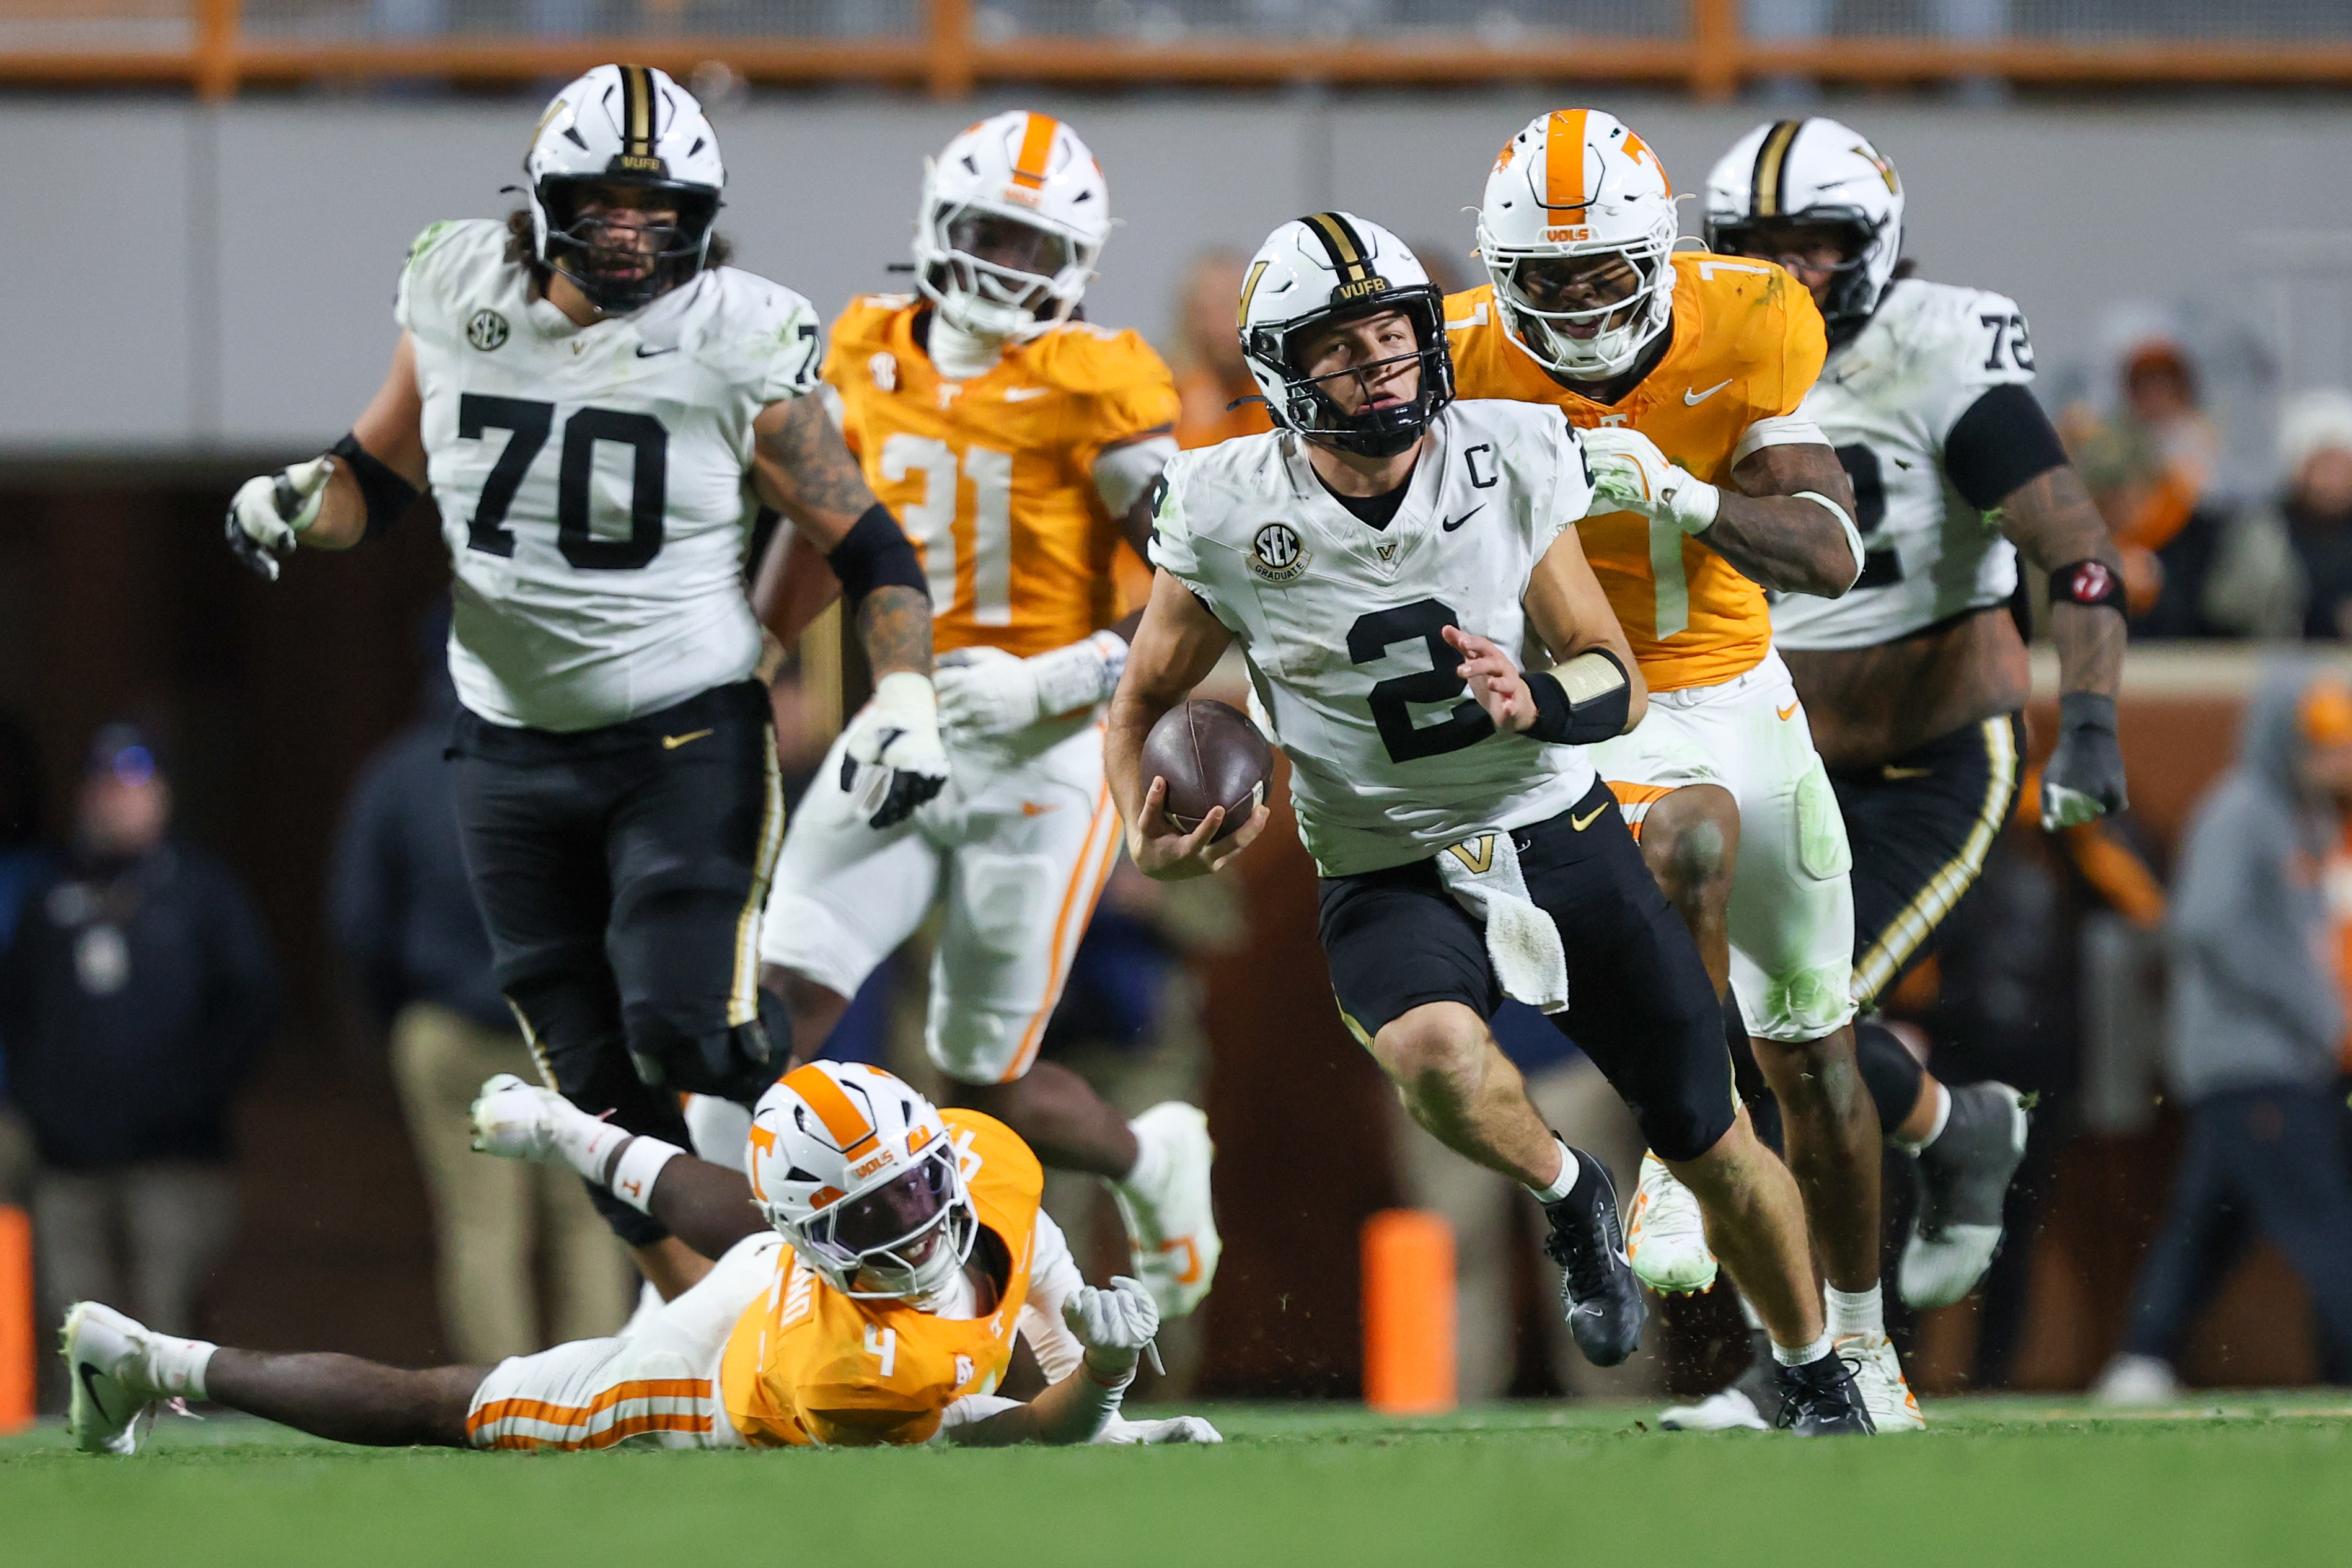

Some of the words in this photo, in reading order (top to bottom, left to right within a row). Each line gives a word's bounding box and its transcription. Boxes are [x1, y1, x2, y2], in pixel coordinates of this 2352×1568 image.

[1547, 228, 1589, 242] VOLS
[1339, 278, 1386, 300] VUFB
[796, 325, 822, 384] 7
[1980, 314, 2037, 372] 72
[457, 392, 669, 570] 70
[1464, 444, 1498, 488] C
[879, 433, 1013, 627] 31
[1255, 526, 1299, 567] SEC
[1255, 560, 1305, 581] GRADUATE
[1346, 598, 1496, 764] 2
[1444, 834, 1495, 874] V
[855, 1149, 894, 1178] VOLS
[863, 1323, 896, 1377] 4
